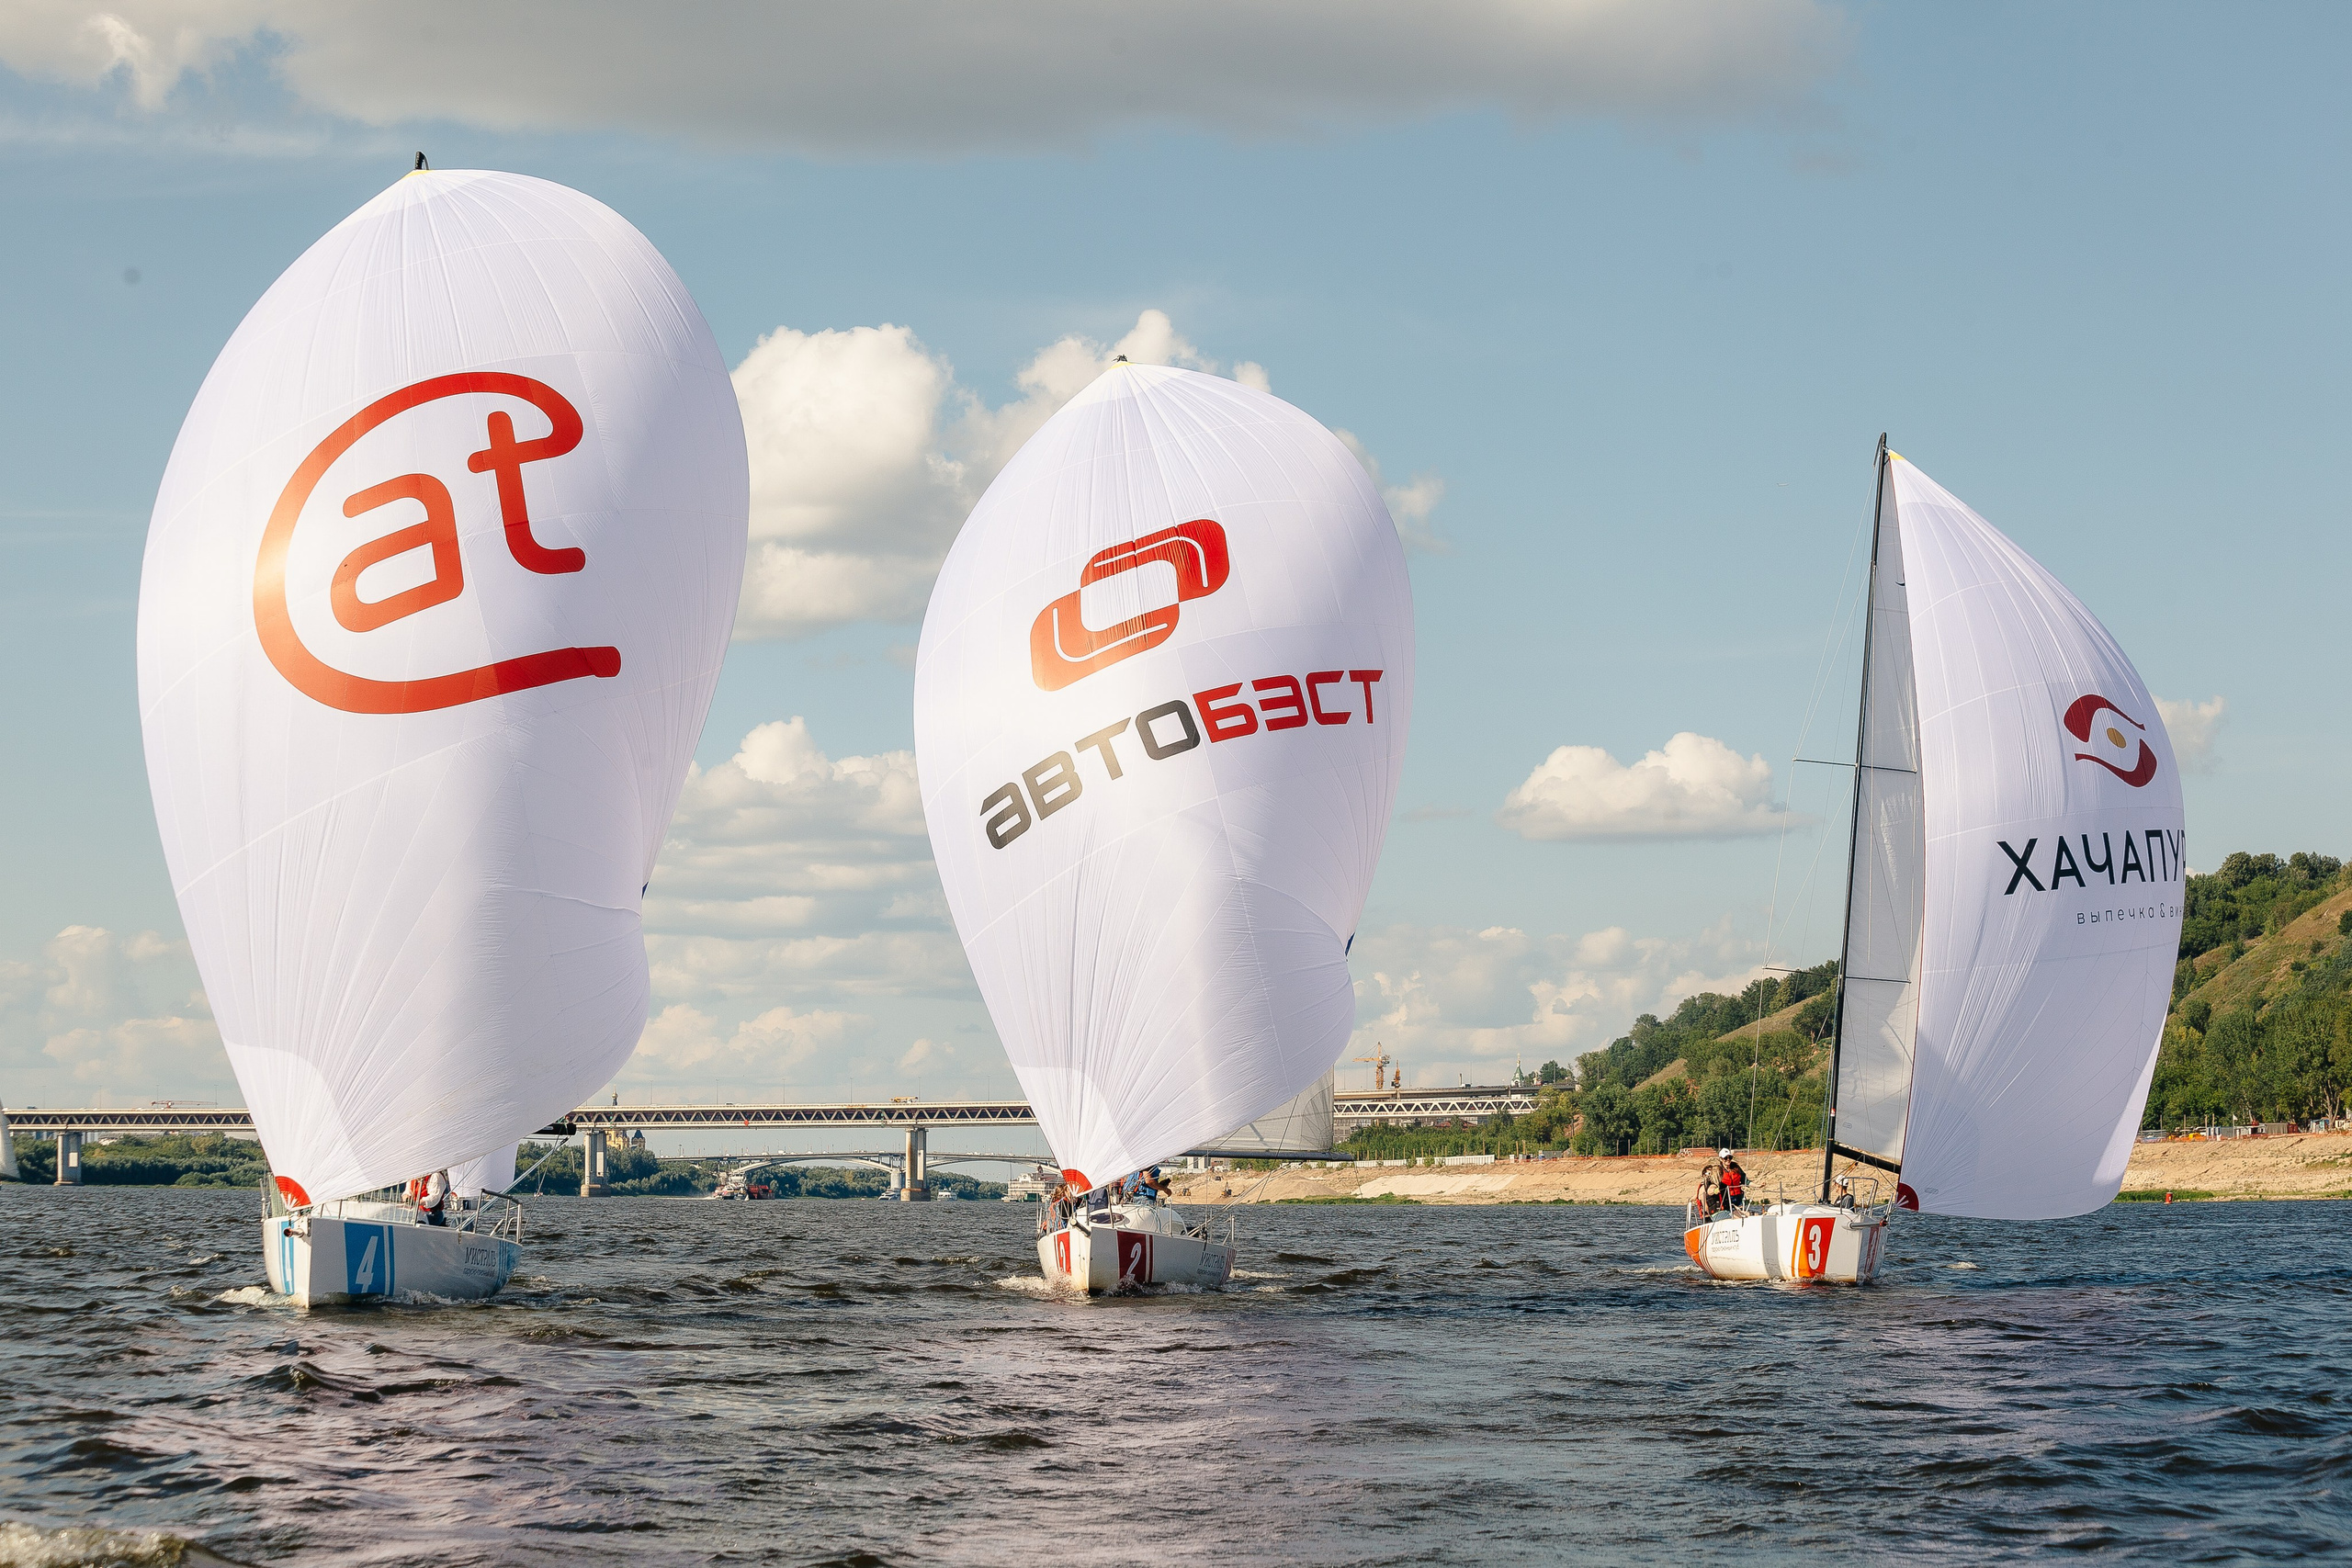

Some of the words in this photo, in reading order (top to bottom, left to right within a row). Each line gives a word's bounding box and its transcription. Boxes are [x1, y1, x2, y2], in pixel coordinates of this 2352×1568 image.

[2076, 907, 2154, 924] выпечка
[2159, 902, 2165, 918] &
[356, 1235, 379, 1293] 4
[1126, 1242, 1142, 1280] 2
[1808, 1224, 1822, 1270] 3
